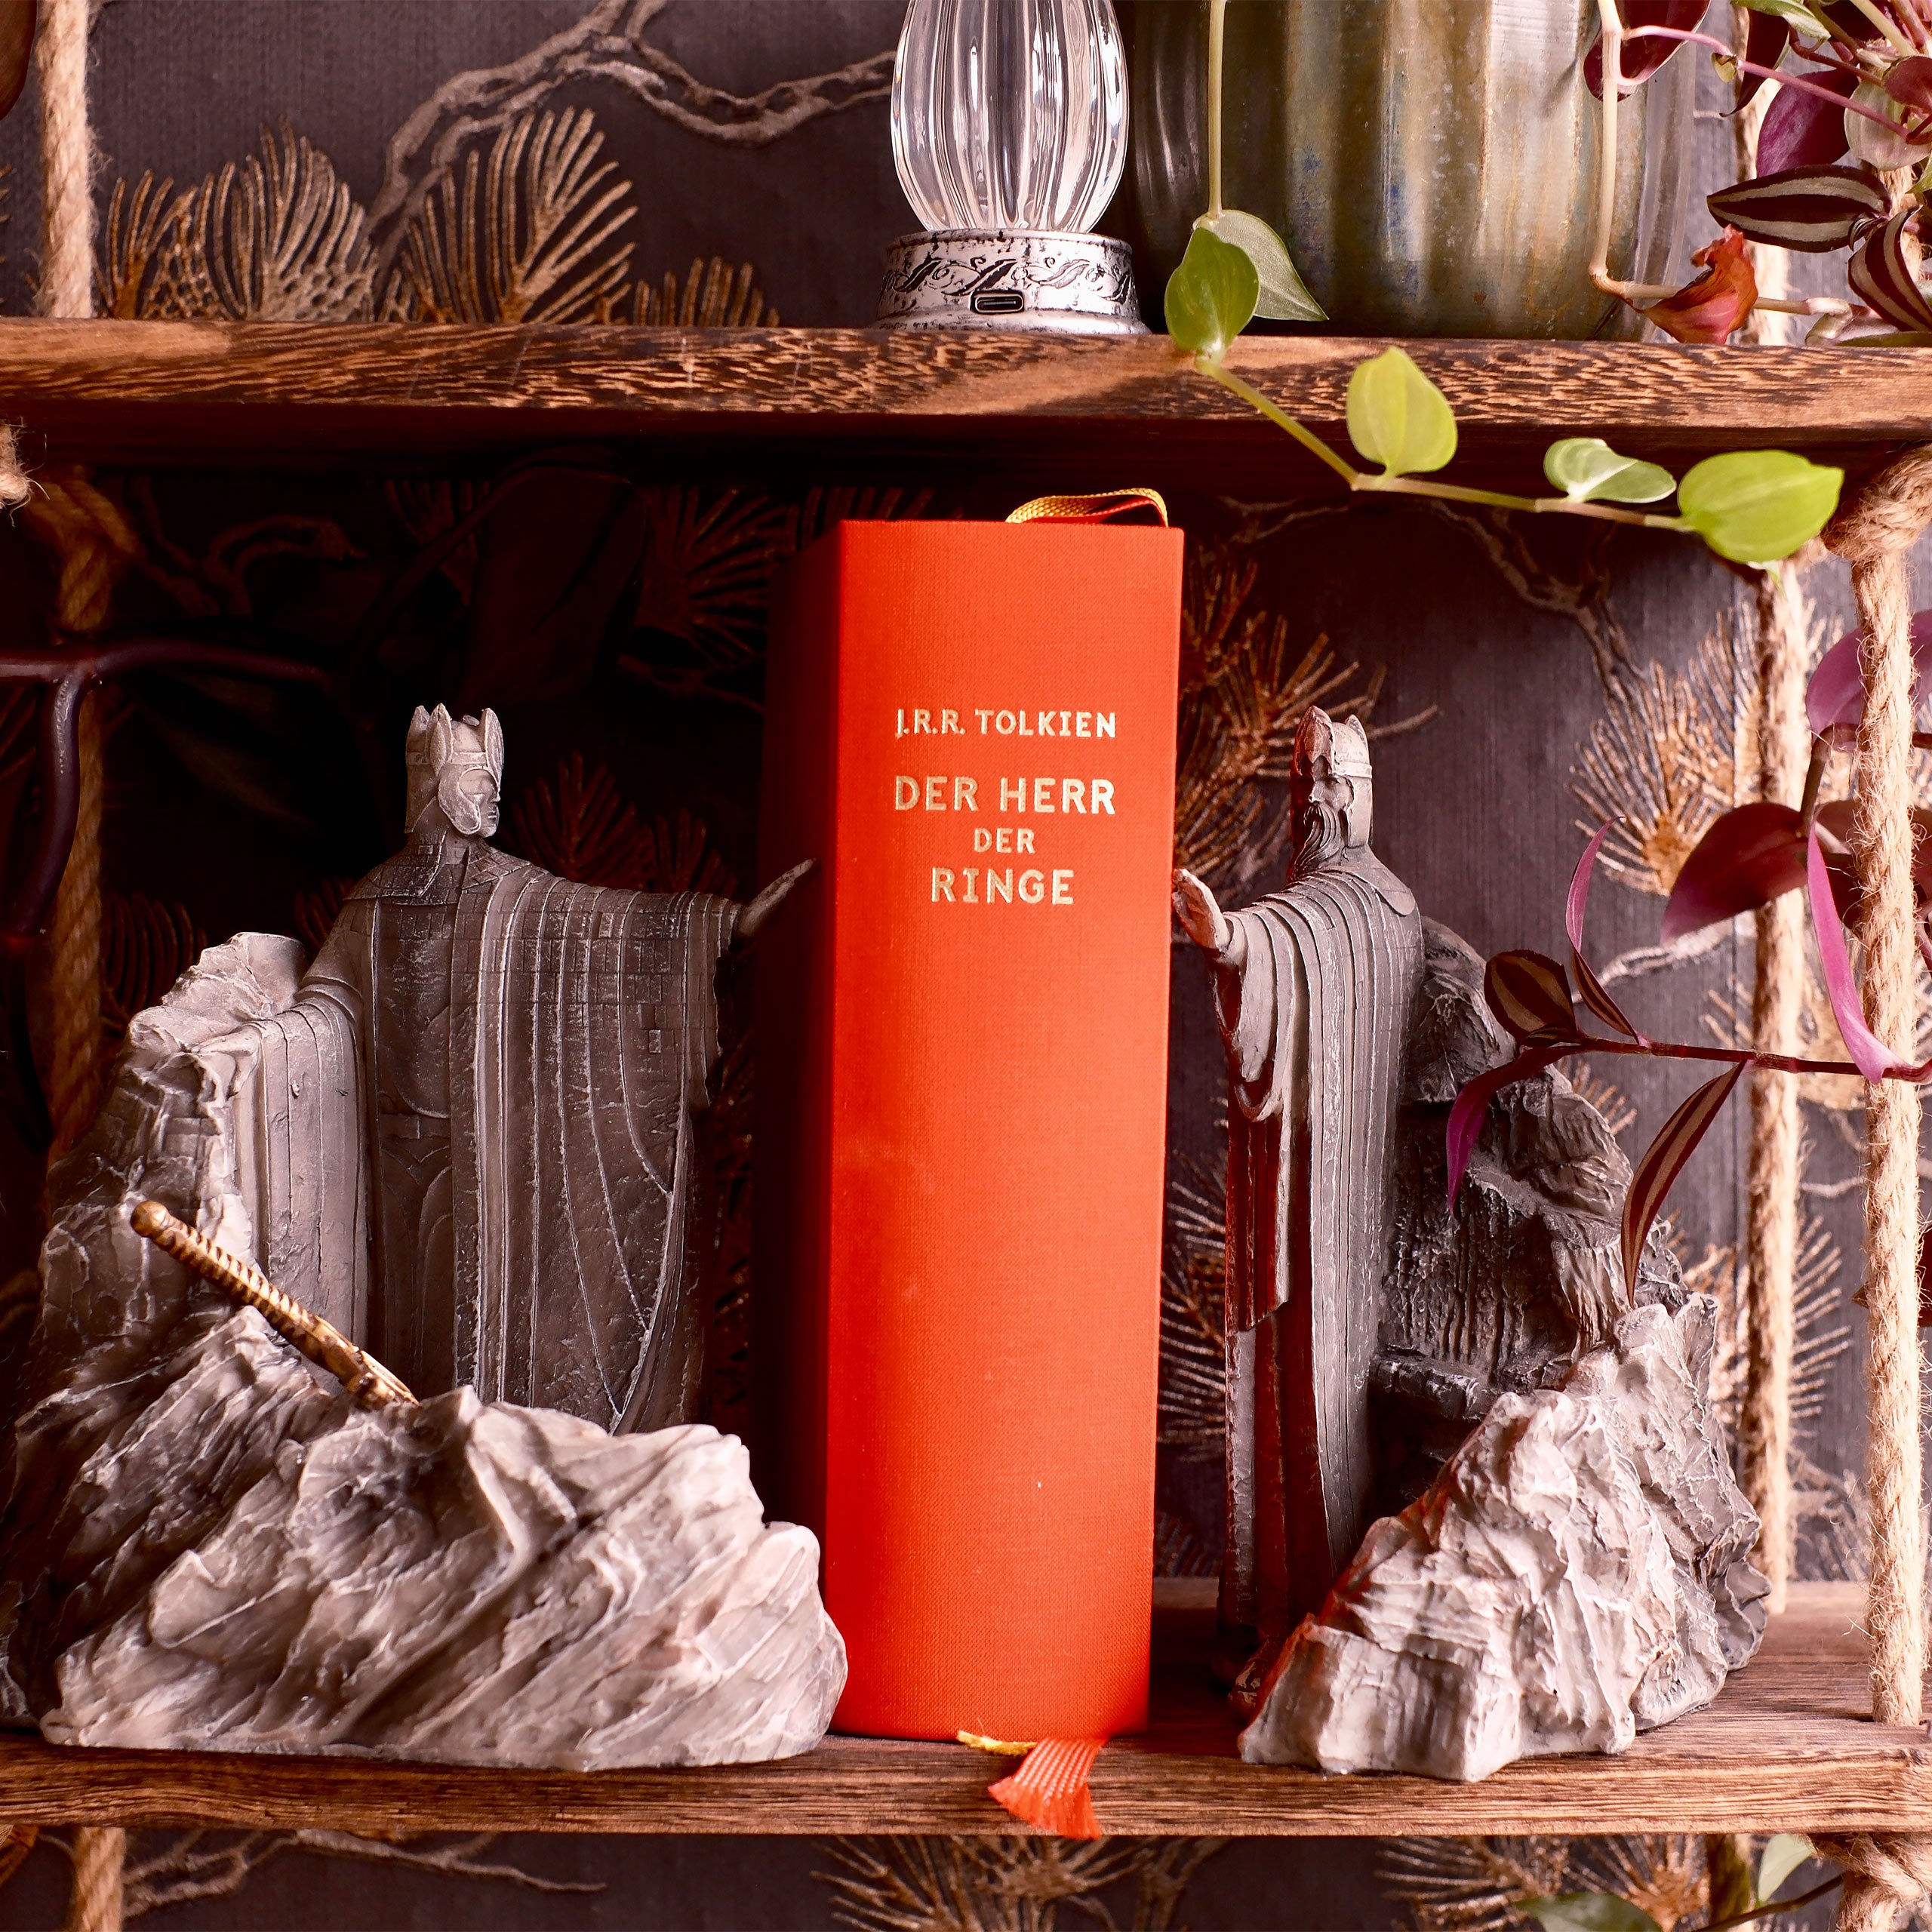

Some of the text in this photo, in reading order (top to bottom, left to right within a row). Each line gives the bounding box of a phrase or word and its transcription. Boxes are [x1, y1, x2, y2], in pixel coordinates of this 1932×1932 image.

[894, 708, 1117, 740] J.R.R. TOLKIEN
[894, 775, 1117, 816] DER HERR
[974, 827, 1036, 854] DER
[931, 866, 1075, 906] RINGE
